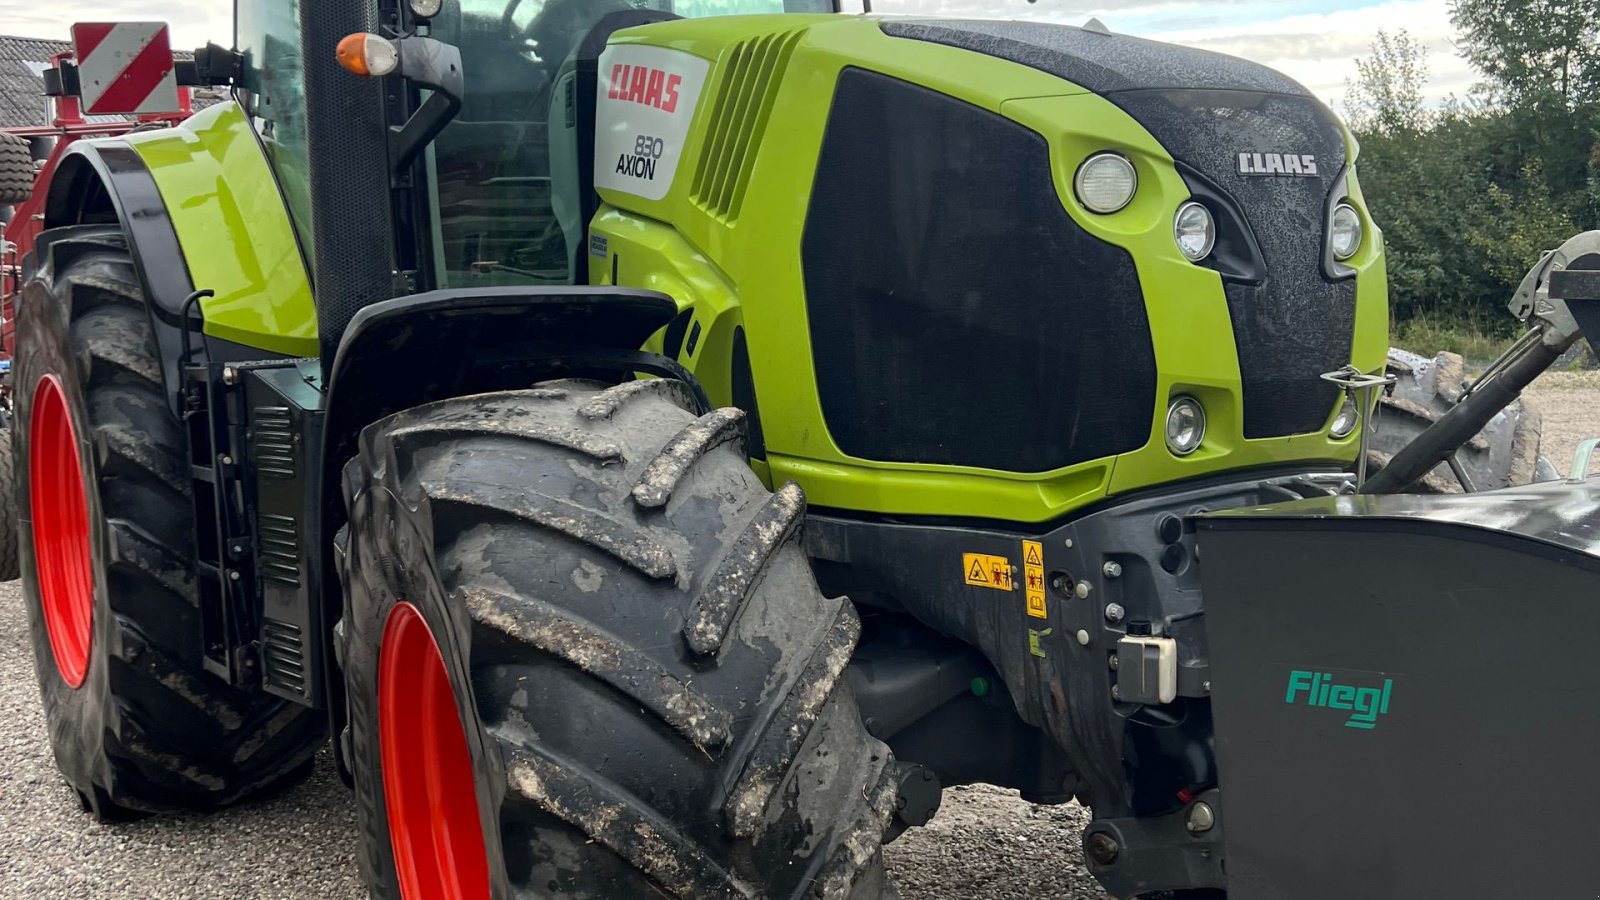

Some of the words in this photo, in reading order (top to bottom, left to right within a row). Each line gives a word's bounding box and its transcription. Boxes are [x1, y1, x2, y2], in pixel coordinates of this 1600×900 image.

[608, 64, 682, 114] CLAAS
[635, 135, 663, 159] 830
[616, 154, 656, 180] AXION
[1239, 152, 1317, 174] CLAAS
[1286, 670, 1393, 729] Fliegl
